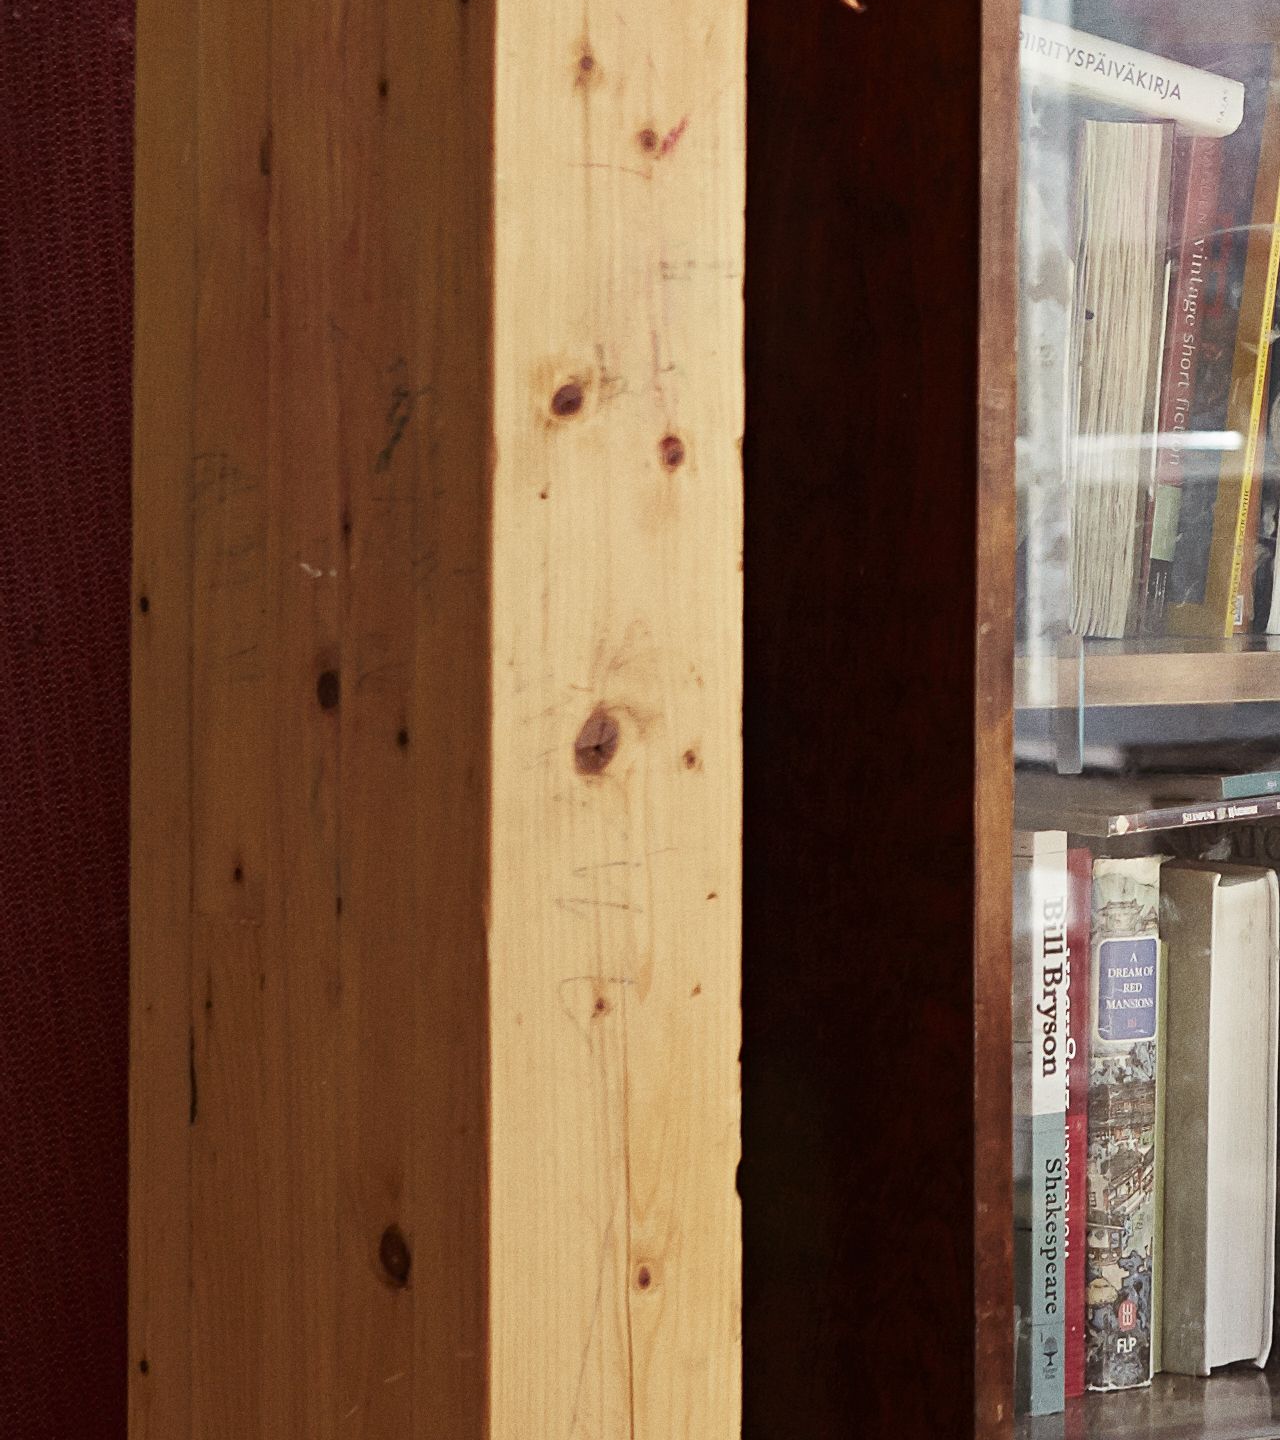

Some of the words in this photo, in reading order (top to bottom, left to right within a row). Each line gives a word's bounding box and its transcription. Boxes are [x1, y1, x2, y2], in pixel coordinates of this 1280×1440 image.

[1182, 238, 1207, 328] vintage
[1177, 334, 1196, 388] short
[1042, 897, 1065, 960] Bill
[1108, 967, 1142, 978] DREAM
[1143, 965, 1155, 977] OF
[1130, 952, 1138, 962] A
[1106, 998, 1154, 1010] MANSIONS
[1123, 982, 1143, 994] RED
[1036, 966, 1065, 1079] Bryson
[1038, 1158, 1062, 1315] Shakespeare
